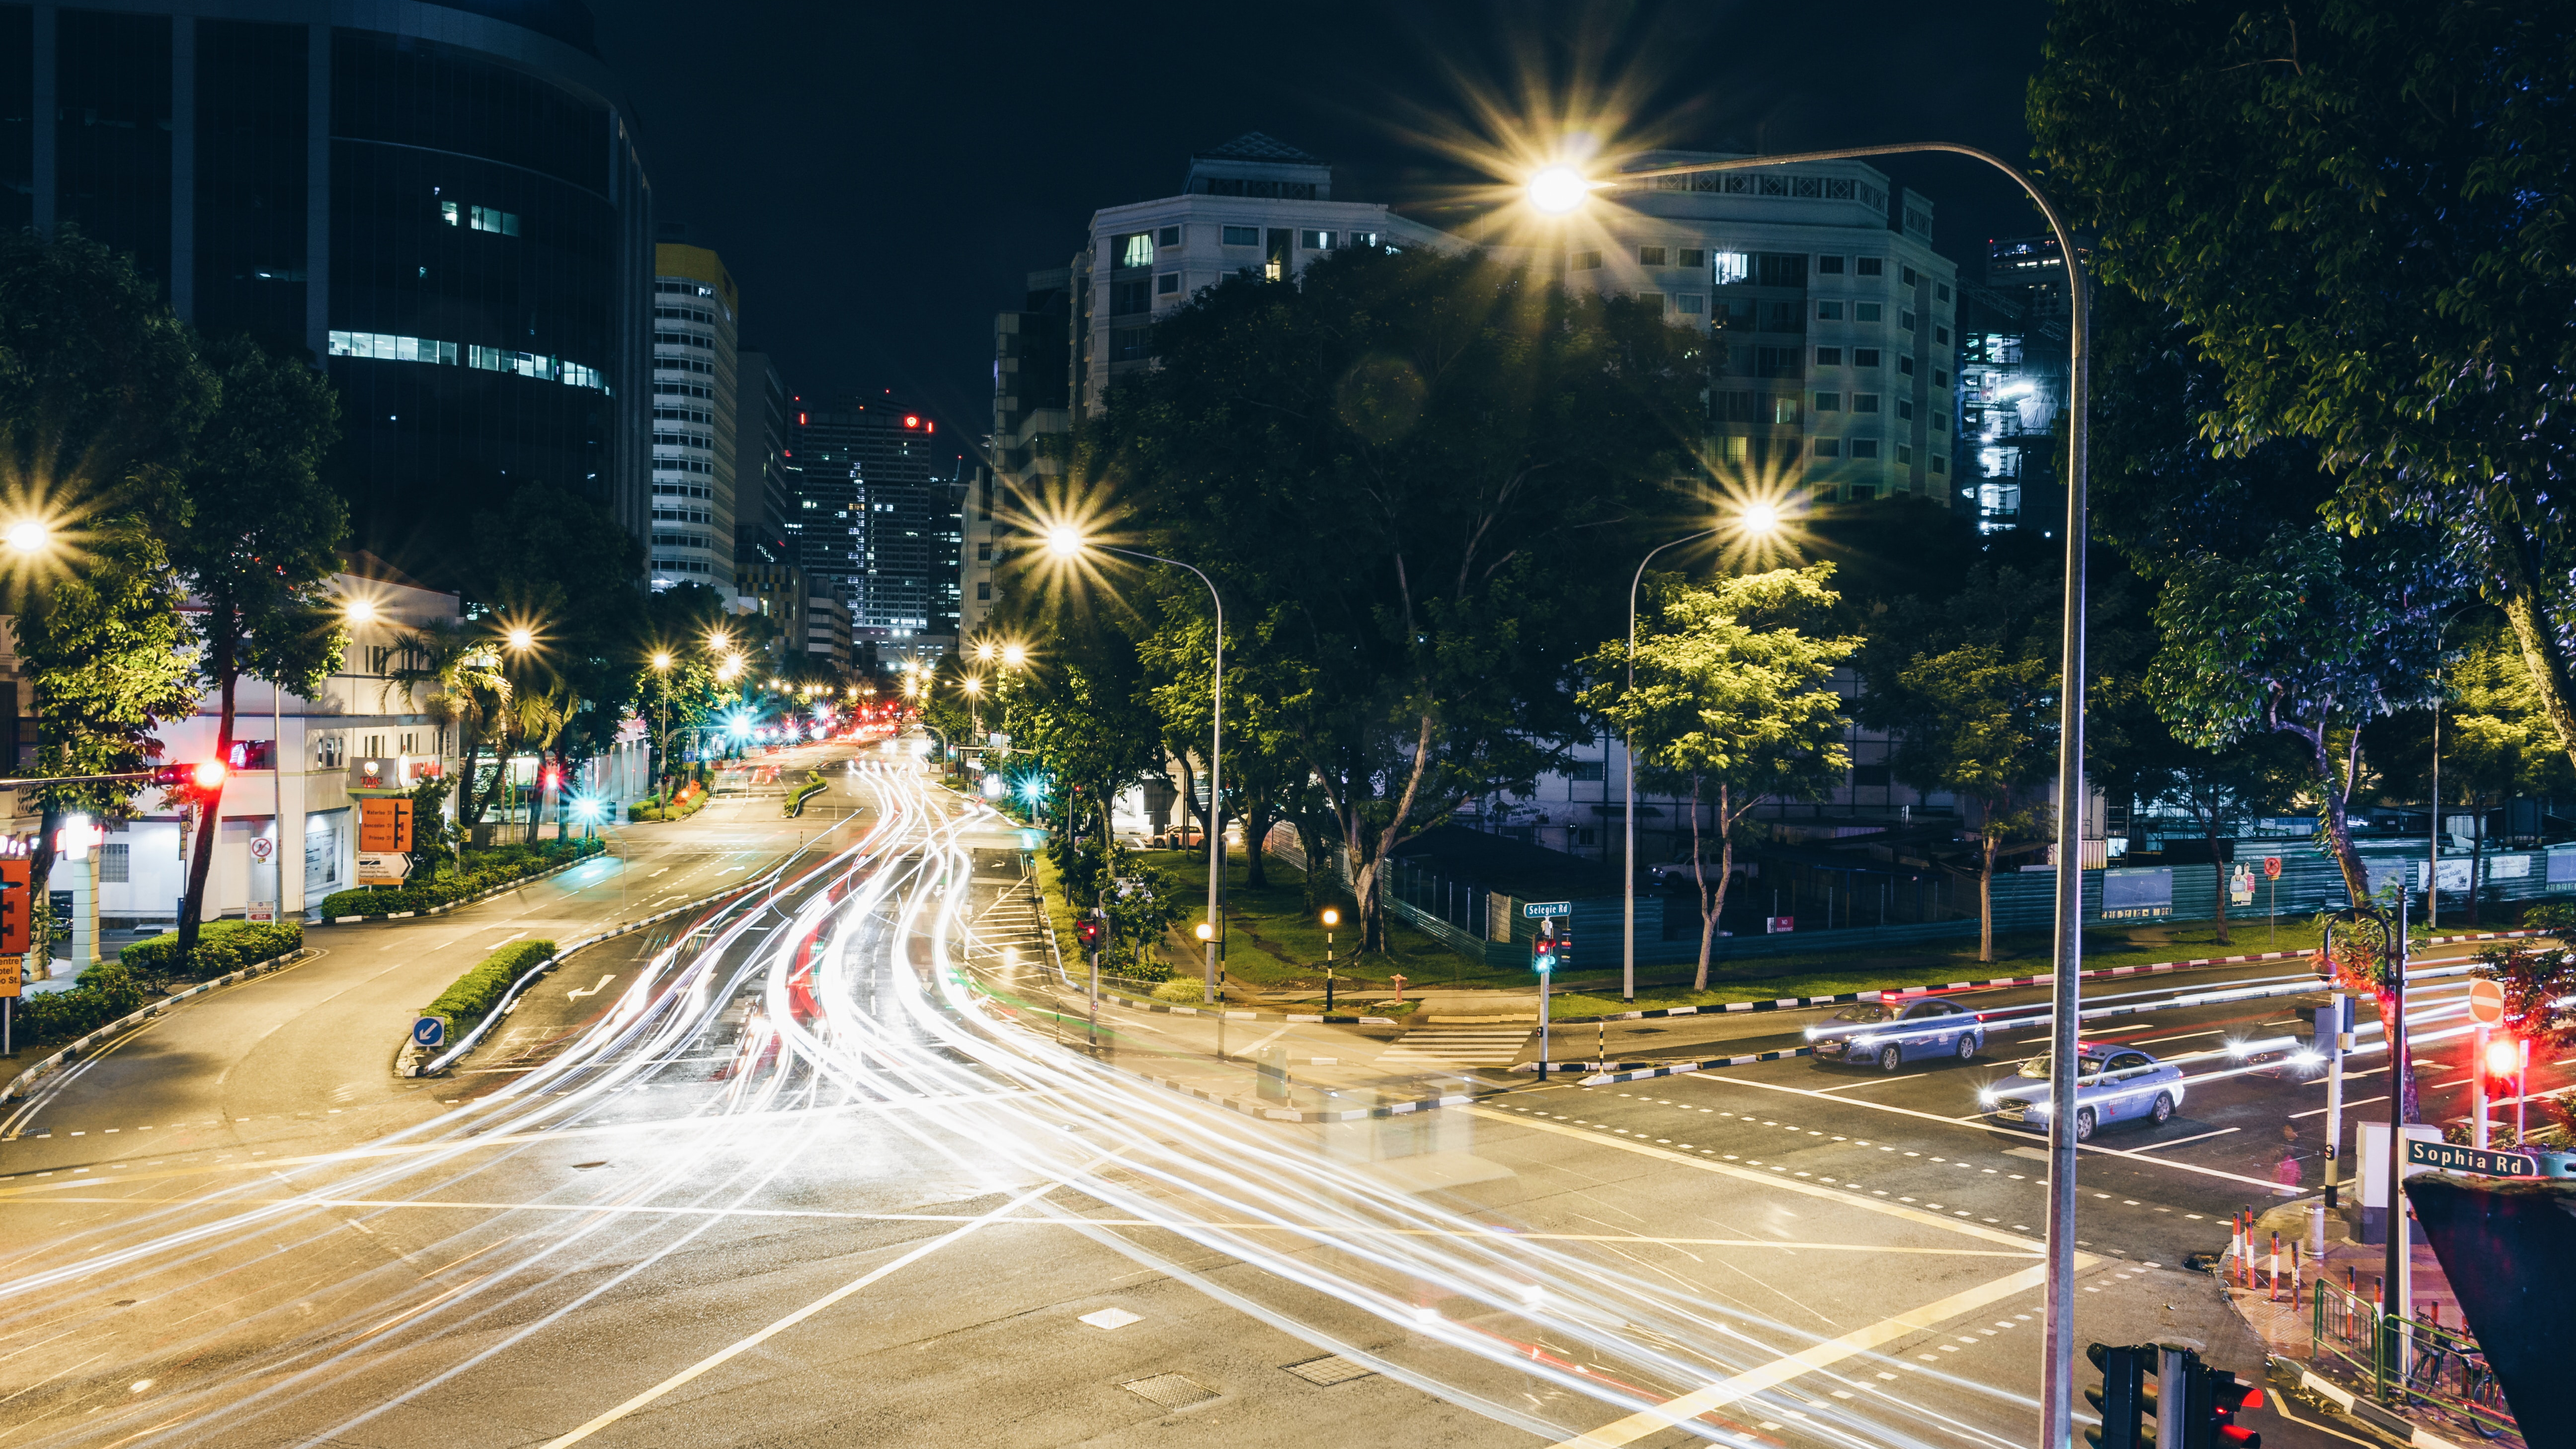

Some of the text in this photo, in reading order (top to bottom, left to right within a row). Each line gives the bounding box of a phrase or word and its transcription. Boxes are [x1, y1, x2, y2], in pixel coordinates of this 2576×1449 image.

[360, 776, 383, 785] TMC
[1529, 904, 1567, 915] Selegie Rd
[2414, 1143, 2521, 1174] Sophia Rd
